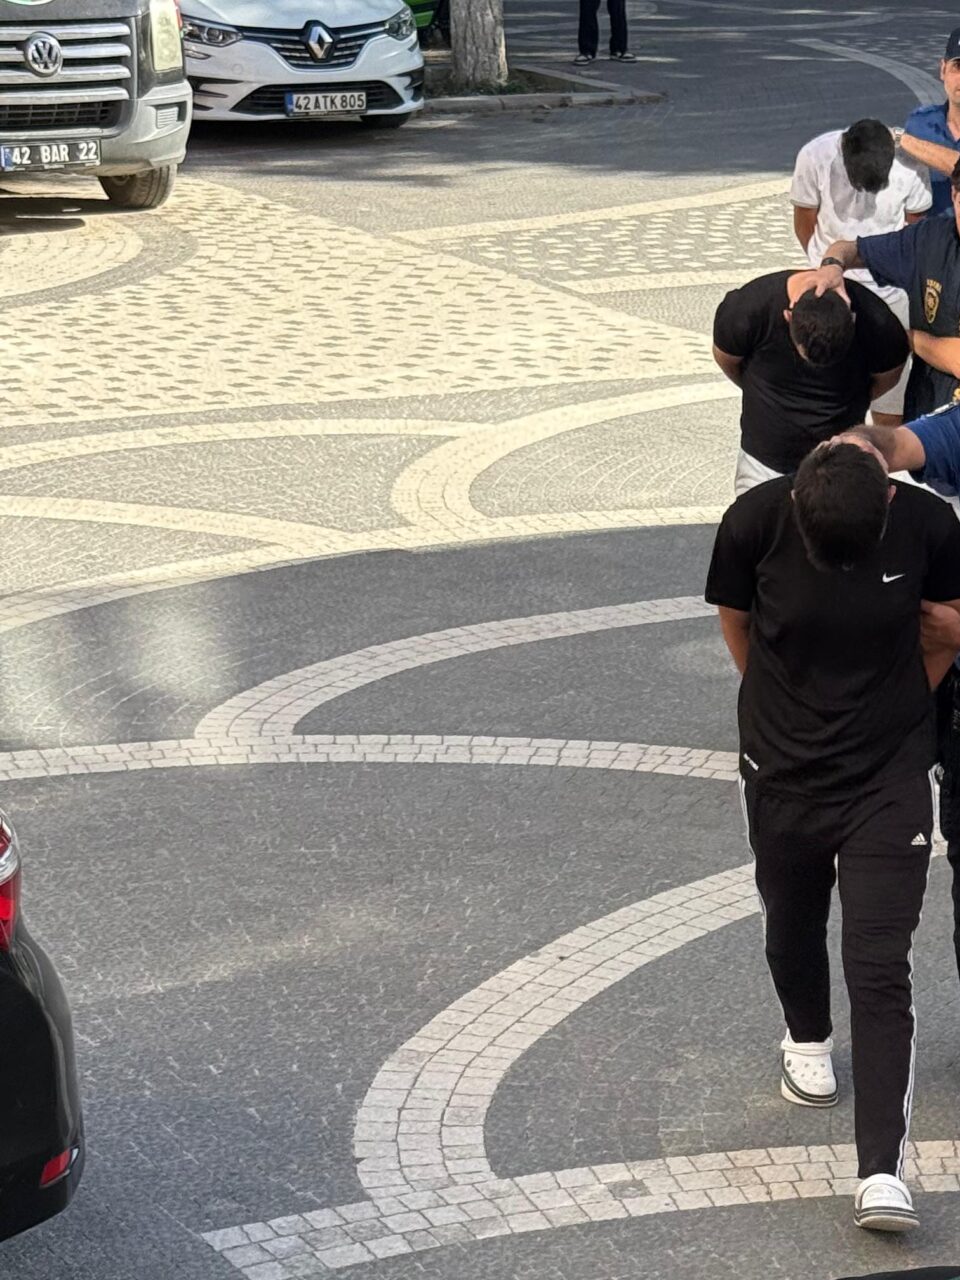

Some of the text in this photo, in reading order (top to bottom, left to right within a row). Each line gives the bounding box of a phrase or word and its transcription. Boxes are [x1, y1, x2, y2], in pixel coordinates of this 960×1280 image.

[294, 93, 365, 111] 42 ATK 805
[12, 142, 97, 164] 42 BAR 22
